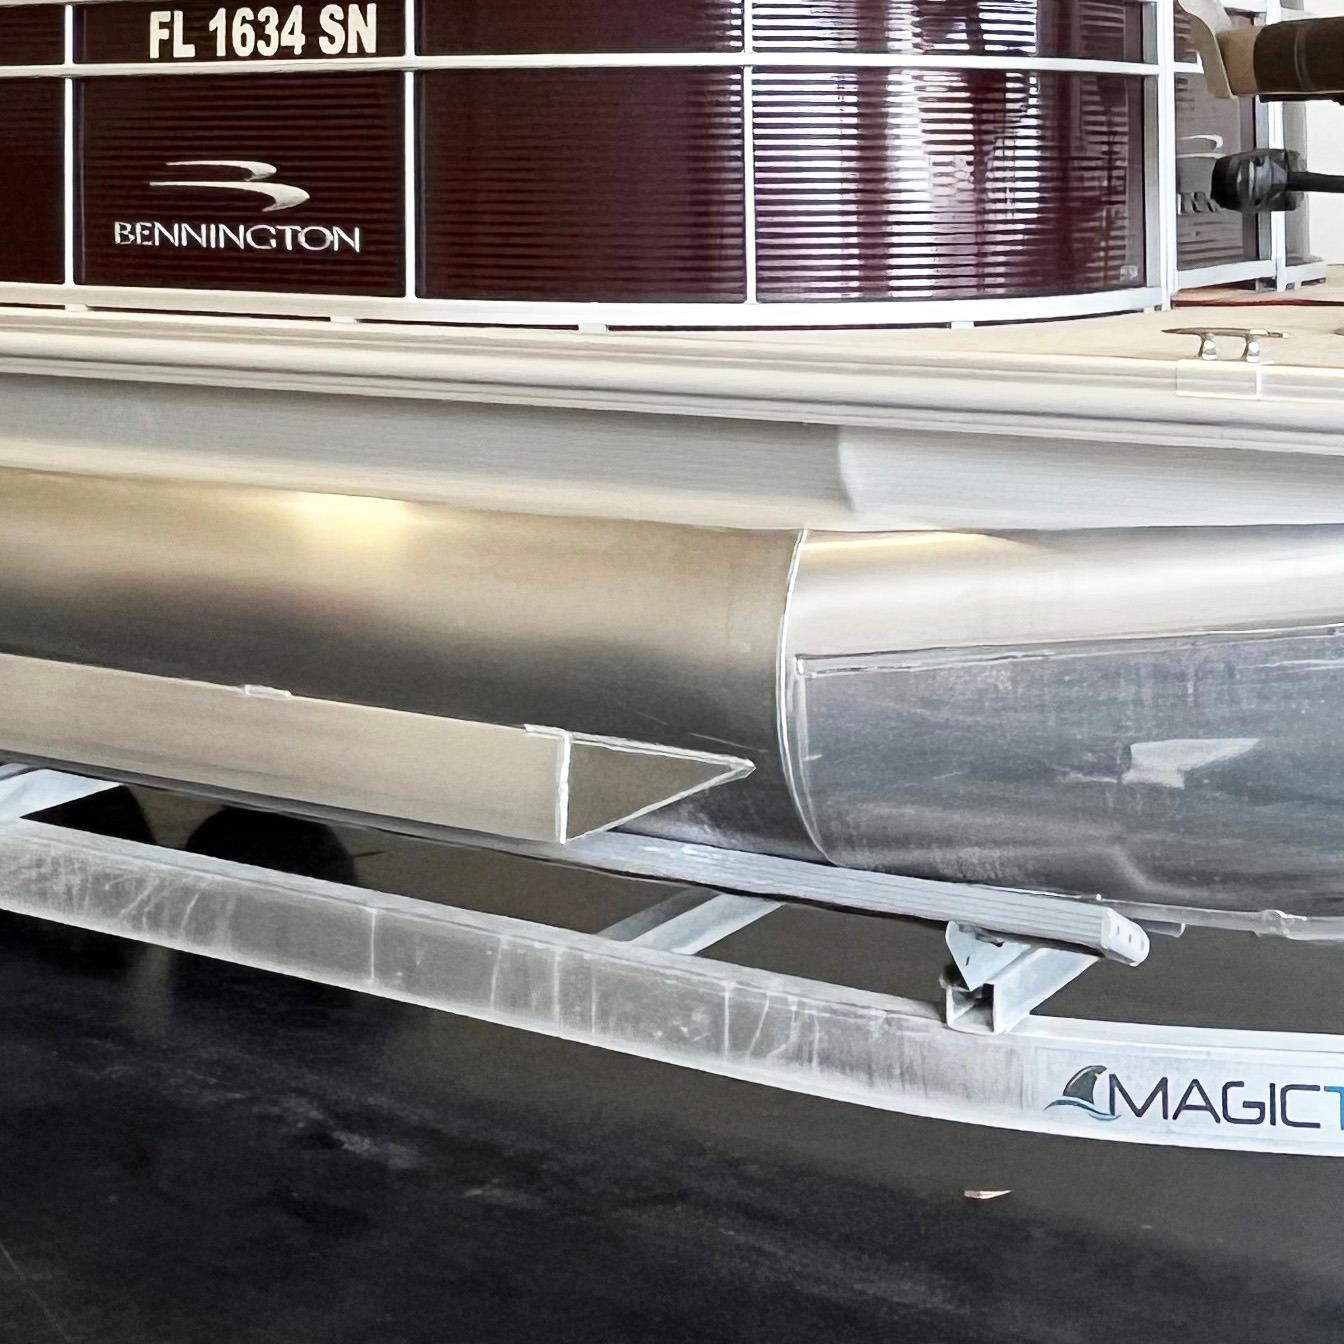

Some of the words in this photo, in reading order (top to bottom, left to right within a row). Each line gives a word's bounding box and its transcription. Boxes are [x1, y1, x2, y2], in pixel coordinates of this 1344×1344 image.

[149, 10, 196, 59] FL
[208, 4, 306, 56] 1634
[318, 2, 377, 54] SN
[114, 221, 361, 253] BENNINGTON
